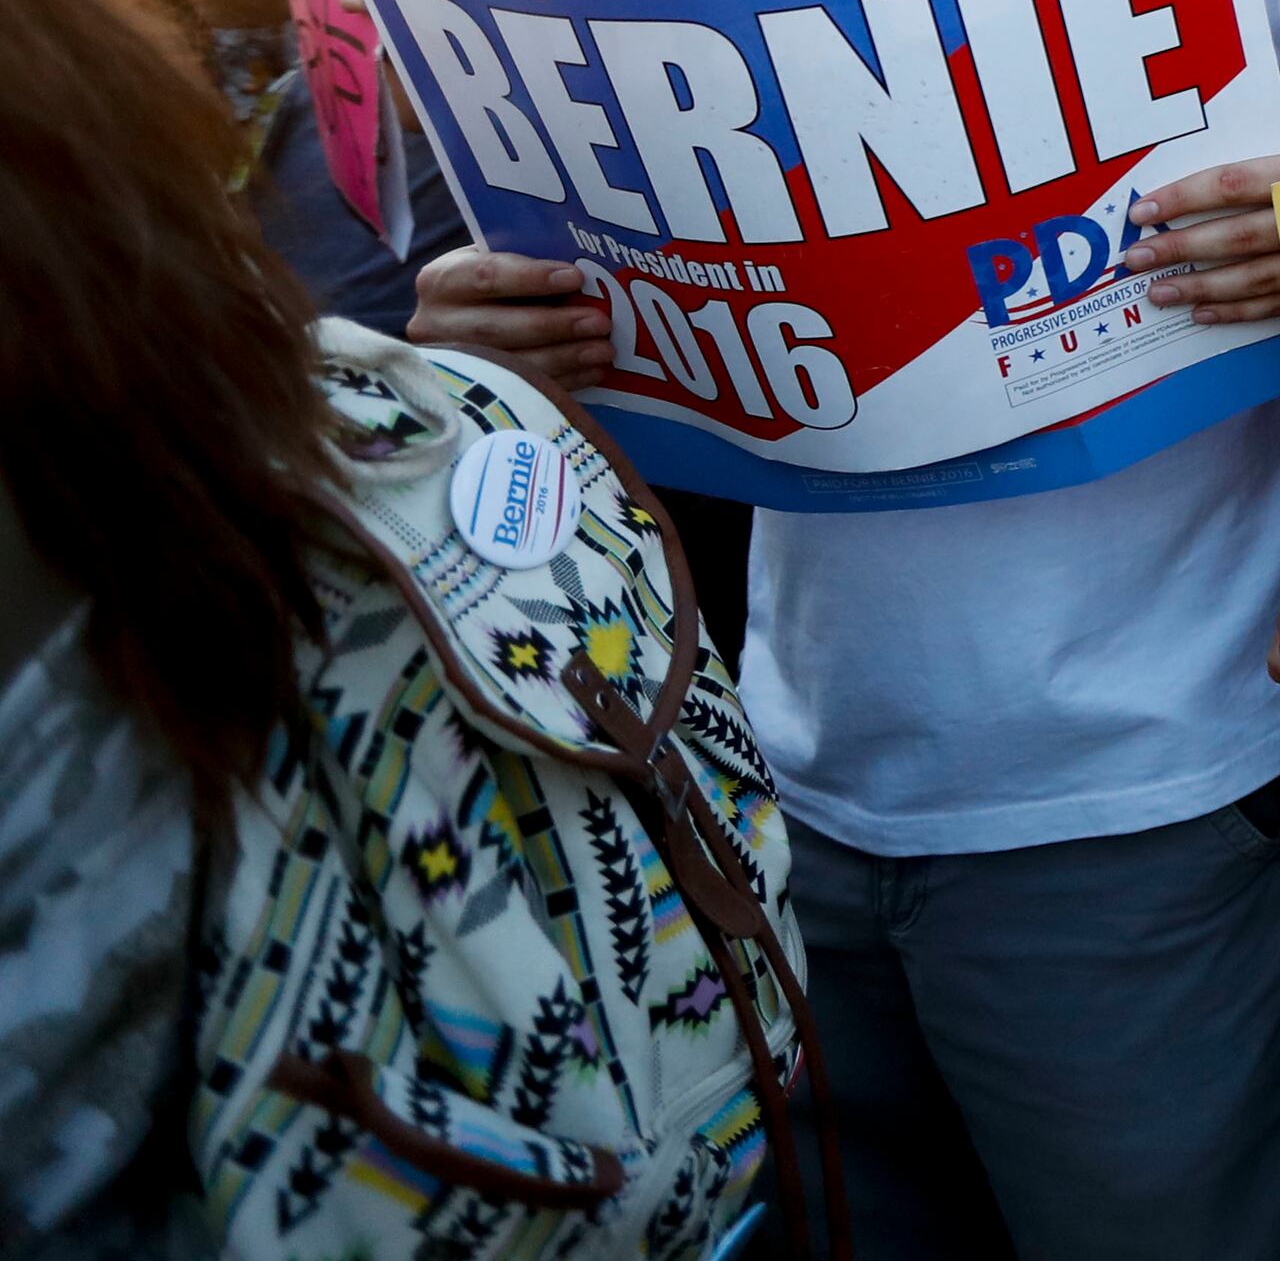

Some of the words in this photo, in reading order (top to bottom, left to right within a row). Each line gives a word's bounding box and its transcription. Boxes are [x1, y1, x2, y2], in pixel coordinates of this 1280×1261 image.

[567, 221, 606, 258] for
[602, 233, 744, 291] President
[743, 260, 786, 292] in
[574, 257, 858, 430] 2016
[991, 313, 1068, 351] PROGRESSIVE
[1068, 286, 1132, 321] DEMOCRATS
[1133, 279, 1149, 295] OF
[492, 441, 536, 548] Bernie
[536, 487, 549, 515] 2016
[938, 469, 973, 481] 2016
